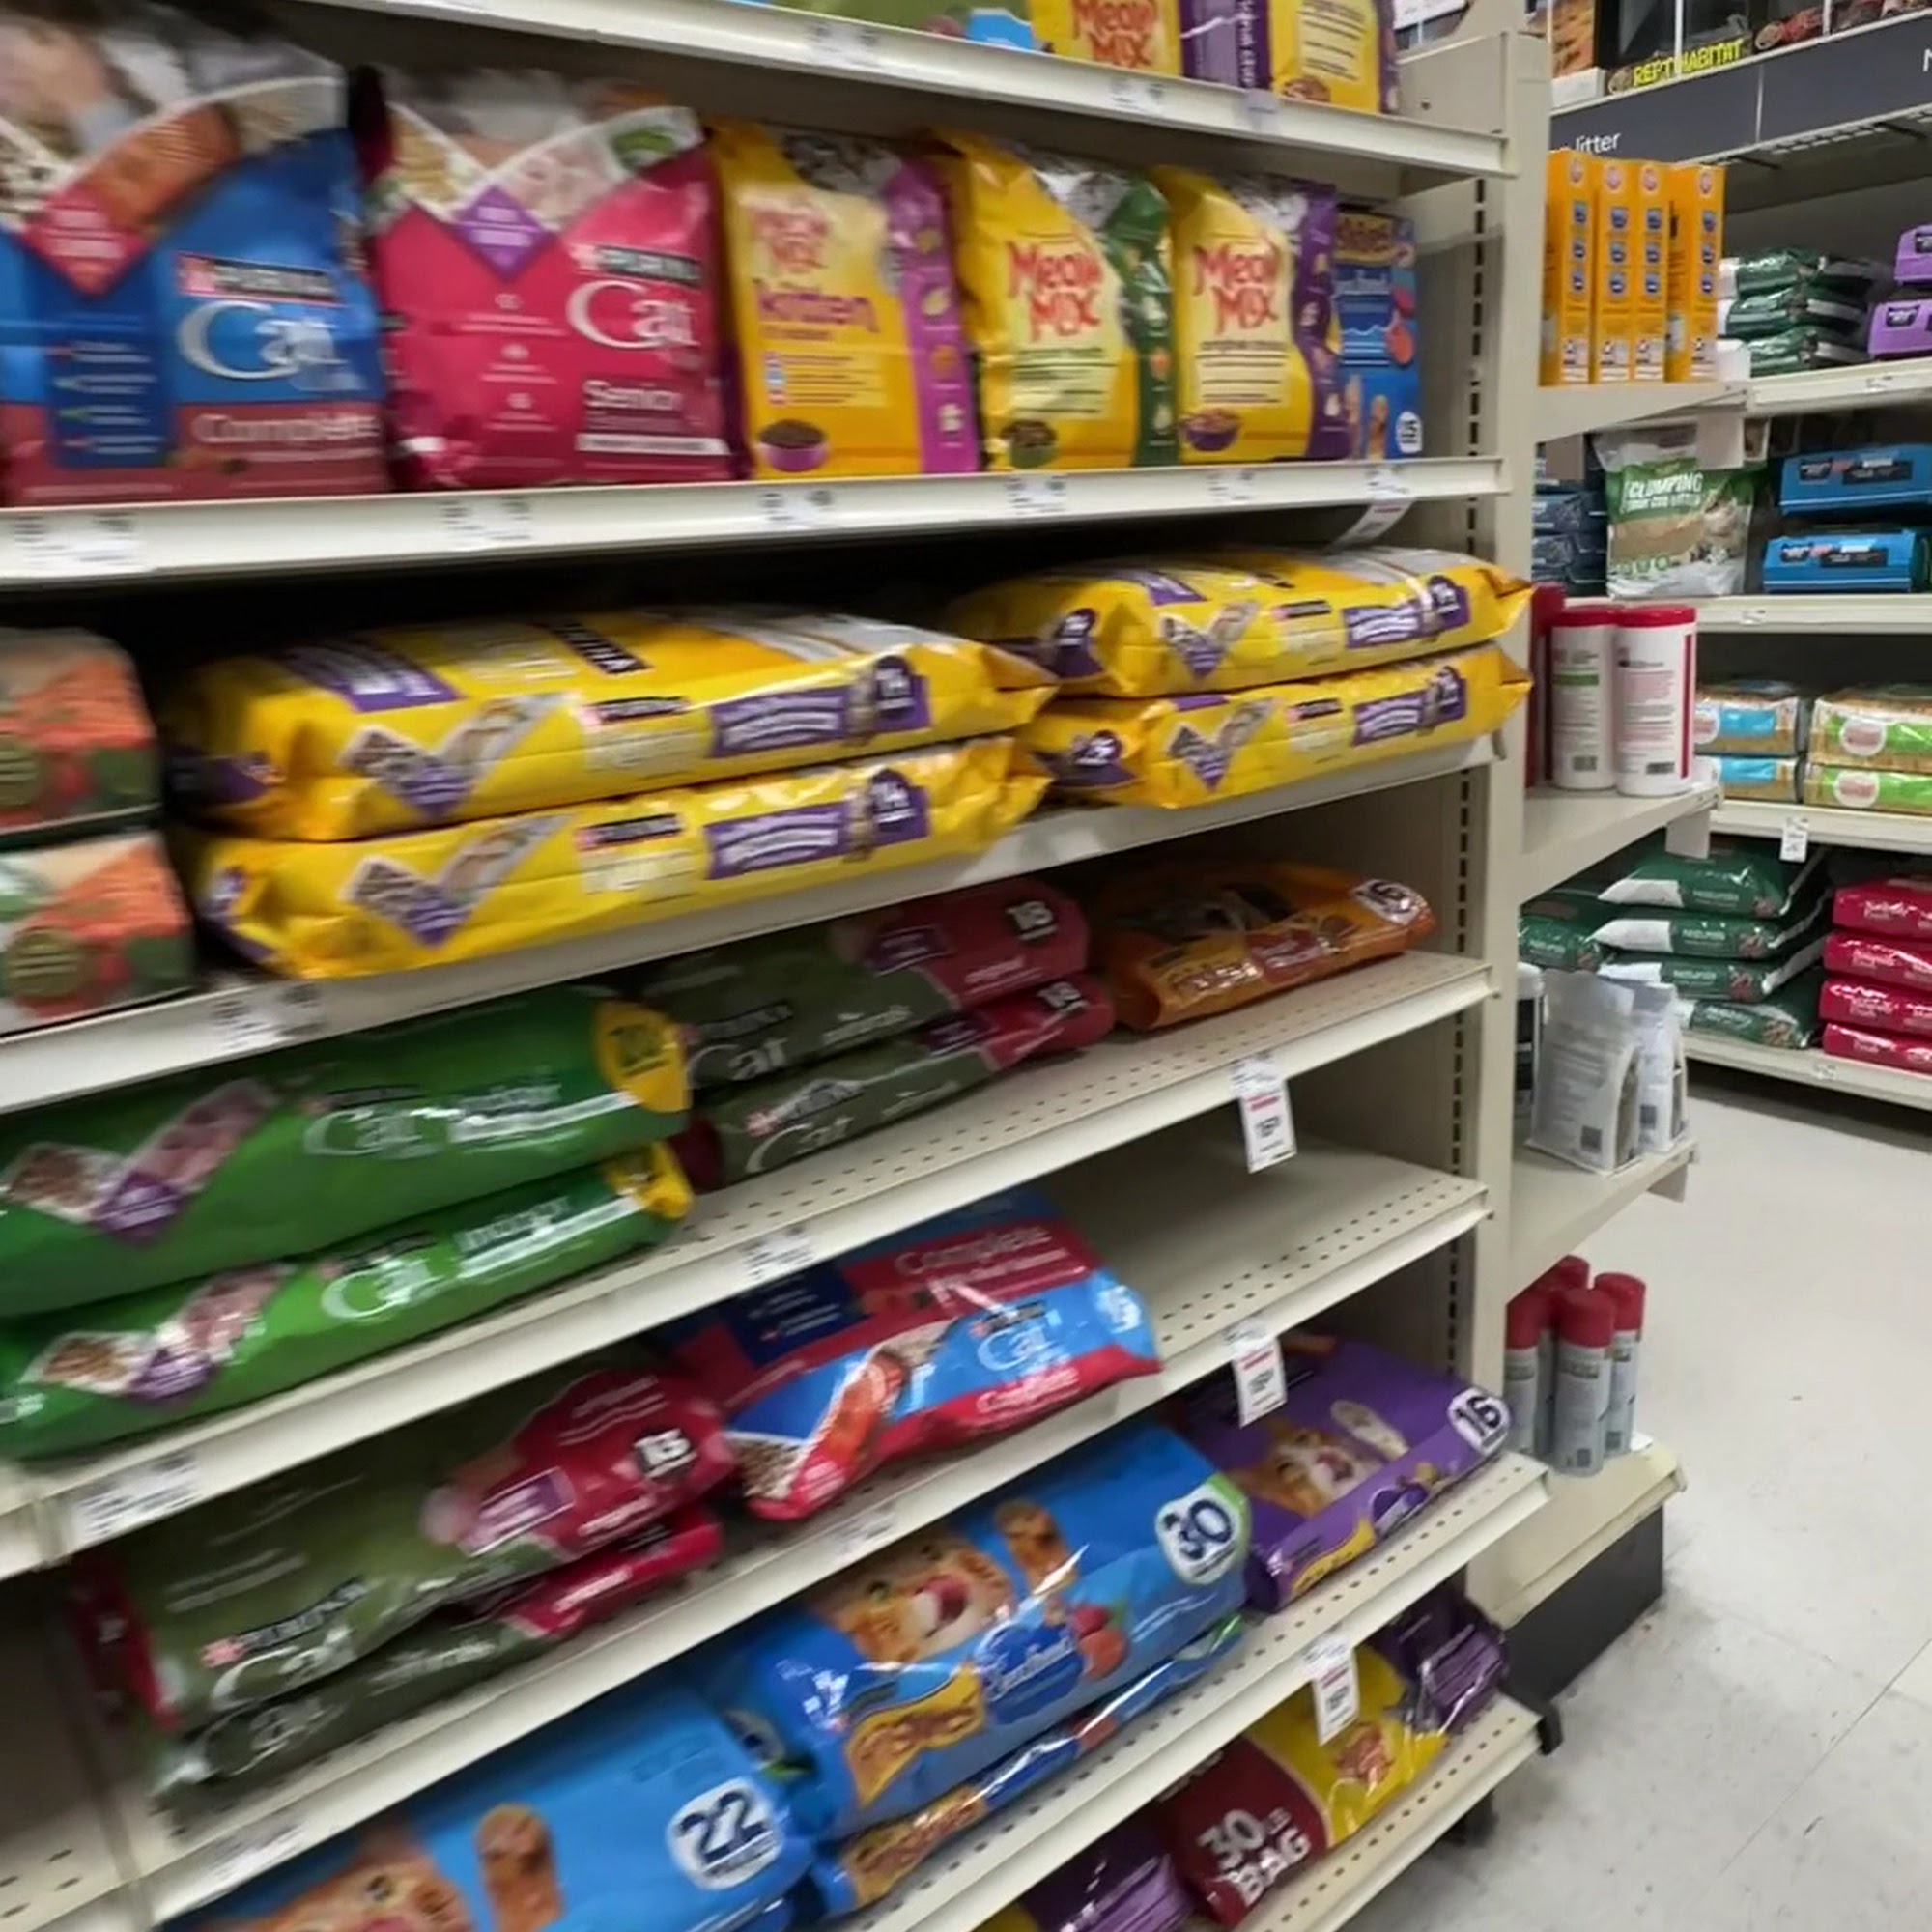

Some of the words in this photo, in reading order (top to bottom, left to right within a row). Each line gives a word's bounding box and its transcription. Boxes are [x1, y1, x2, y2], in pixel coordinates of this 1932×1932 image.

[565, 279, 702, 351] Cat
[1455, 1395, 1502, 1437] 16
[1162, 1498, 1233, 1560] 30
[678, 1790, 769, 1865] 22
[1197, 1809, 1267, 1872] 30
[1229, 1827, 1312, 1908] BAG
